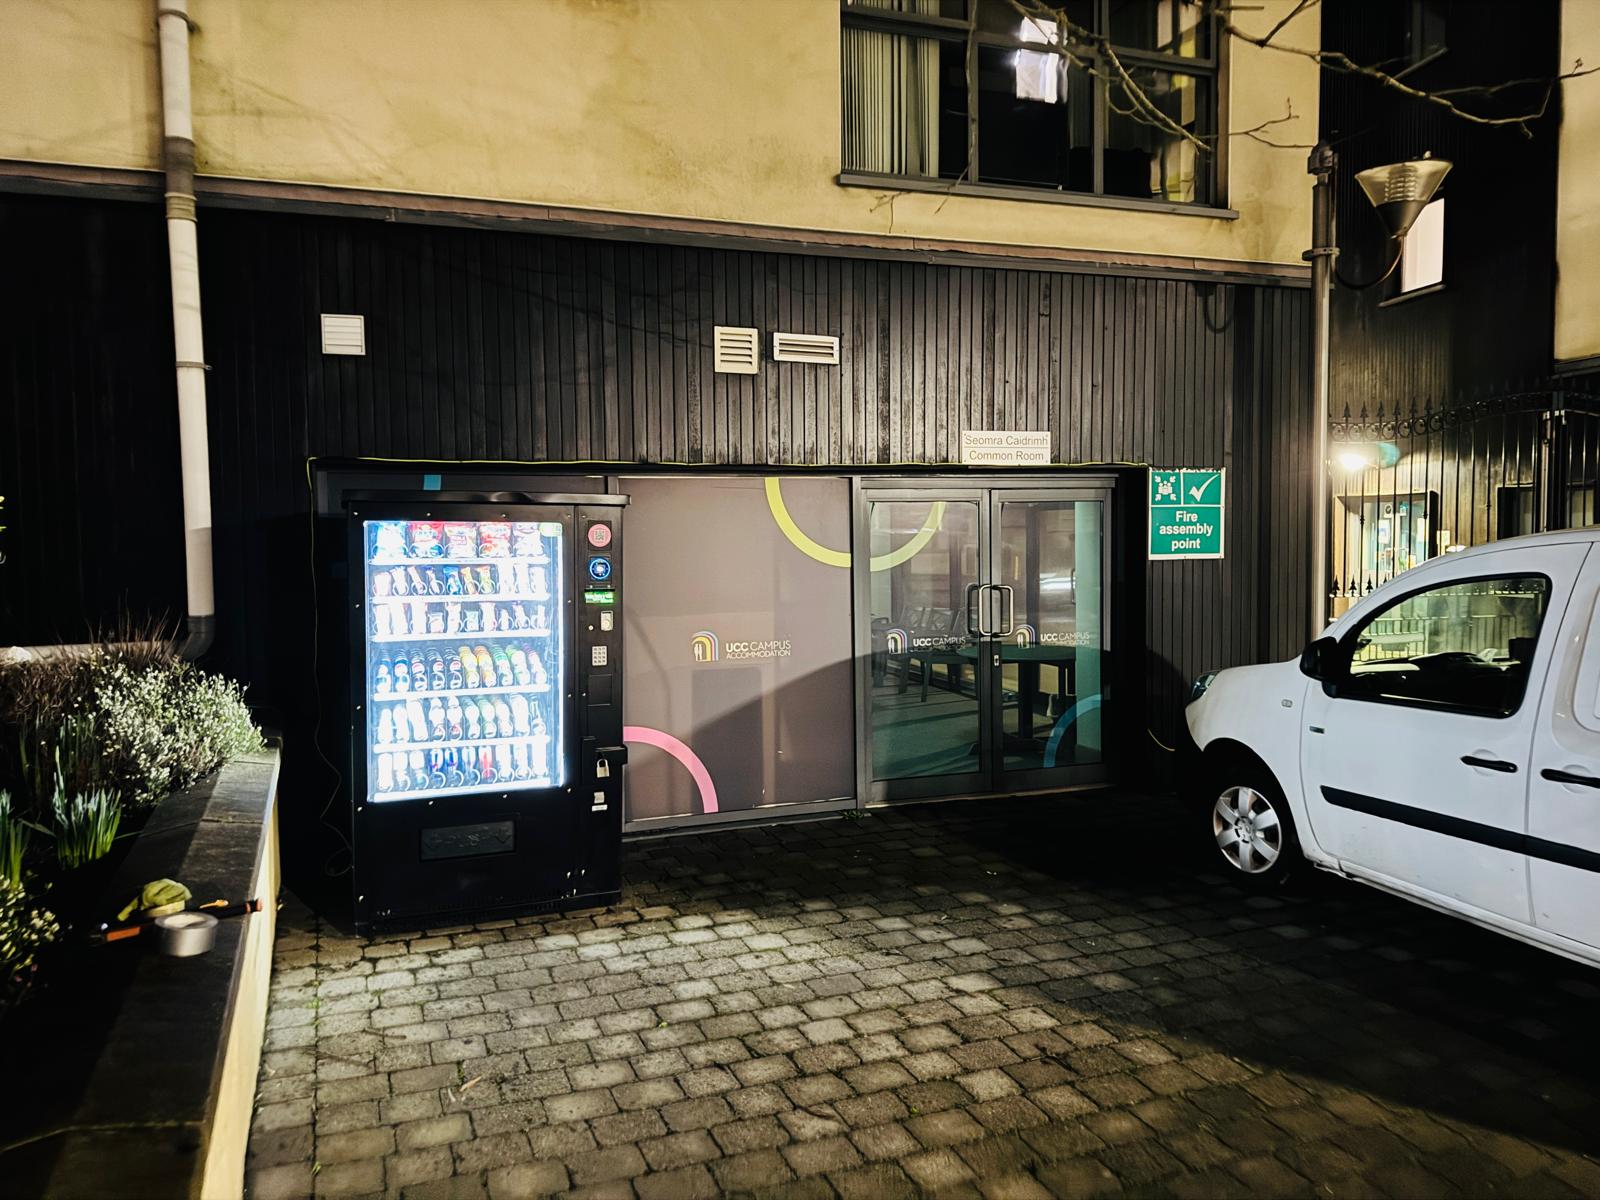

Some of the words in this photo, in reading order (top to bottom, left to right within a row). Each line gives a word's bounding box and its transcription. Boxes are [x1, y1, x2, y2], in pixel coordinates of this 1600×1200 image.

[965, 434, 1003, 446] Seomra
[1005, 435, 1048, 446] Caidrimh
[969, 450, 1013, 461] Common
[1015, 450, 1044, 461] Room
[1175, 510, 1198, 522] Fire
[1159, 523, 1214, 537] assembly
[1171, 538, 1201, 552] point
[912, 638, 932, 647] UCC
[932, 636, 966, 646] CAMPUS
[1040, 633, 1058, 642] UCC
[1058, 631, 1090, 641] CAMPUS
[725, 642, 749, 653] UCC
[749, 640, 792, 652] CAMPUS
[726, 649, 791, 660] ACCOMMODATION
